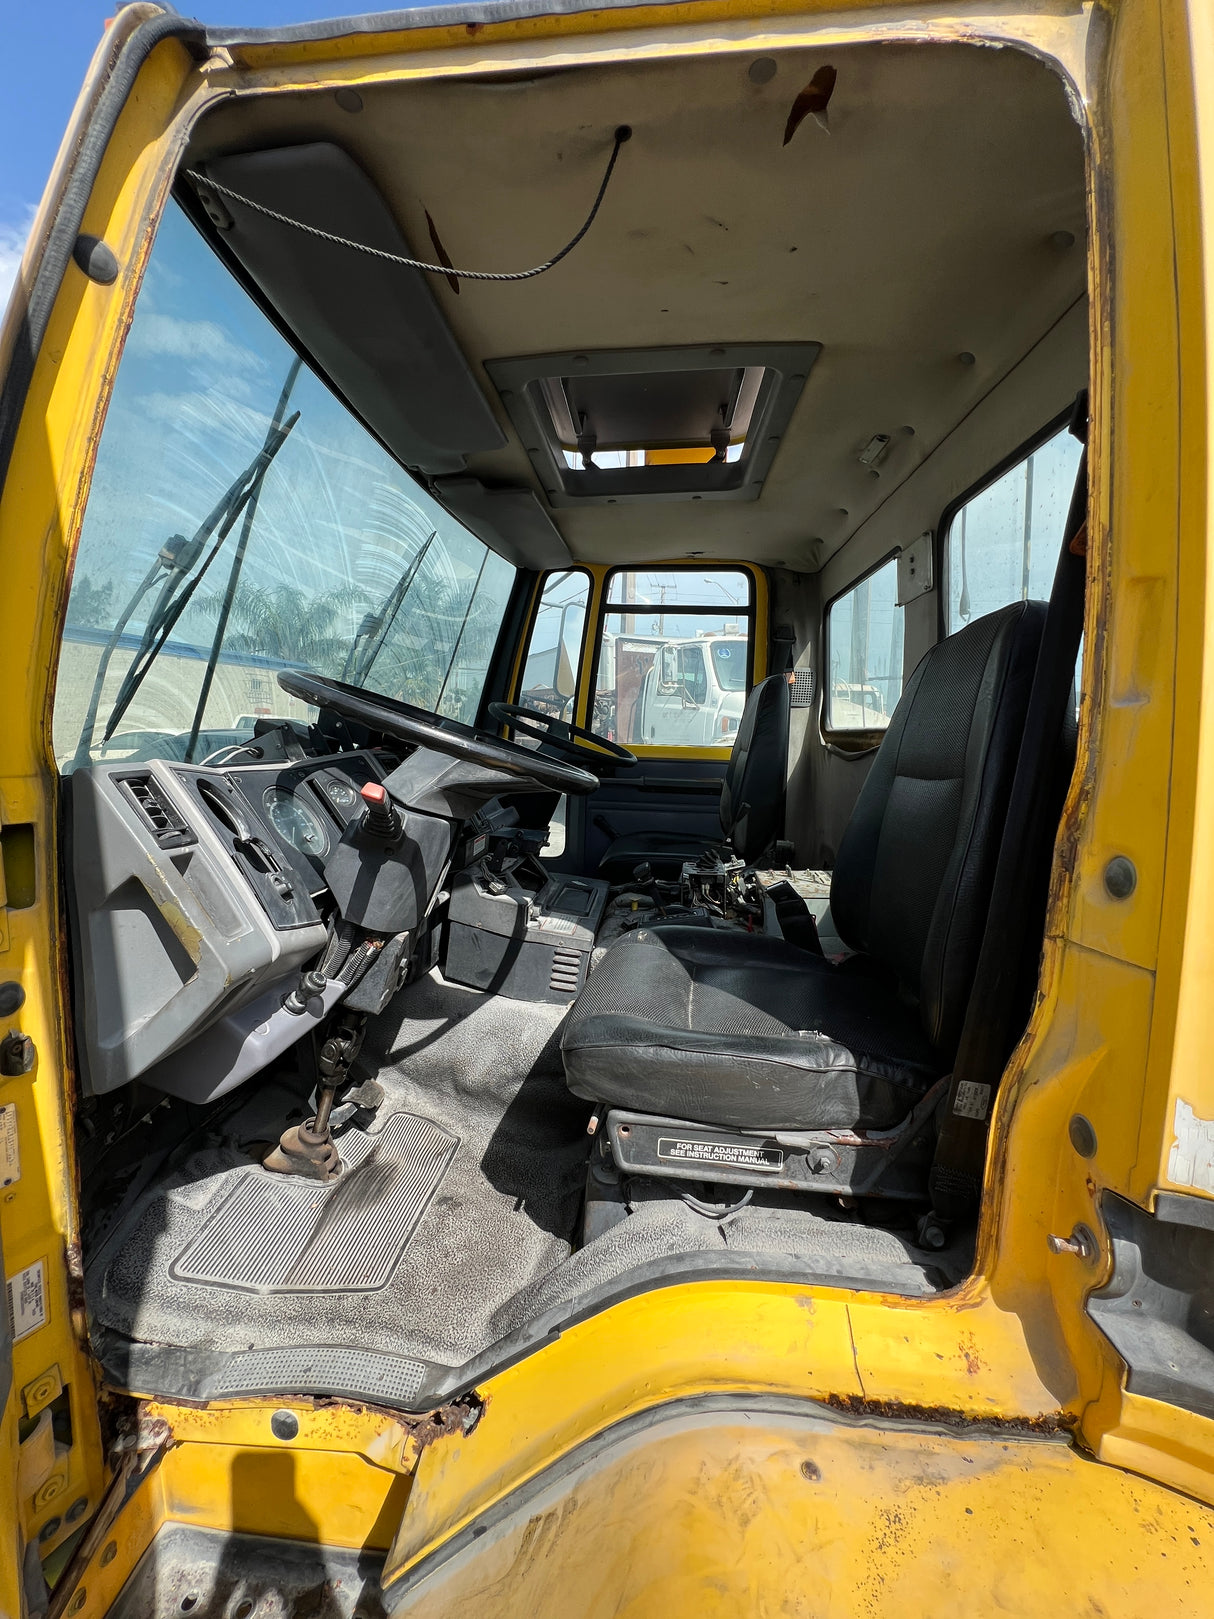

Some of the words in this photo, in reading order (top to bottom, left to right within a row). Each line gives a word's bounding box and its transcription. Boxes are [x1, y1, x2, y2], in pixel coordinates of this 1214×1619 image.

[670, 1148, 686, 1157] SEE
[686, 1150, 737, 1162] INSTRUCTION
[737, 1156, 770, 1165] MANUAL
[676, 1142, 692, 1150] FOR
[693, 1144, 712, 1152] SEAT
[713, 1146, 764, 1158] ADJUSTMENT
